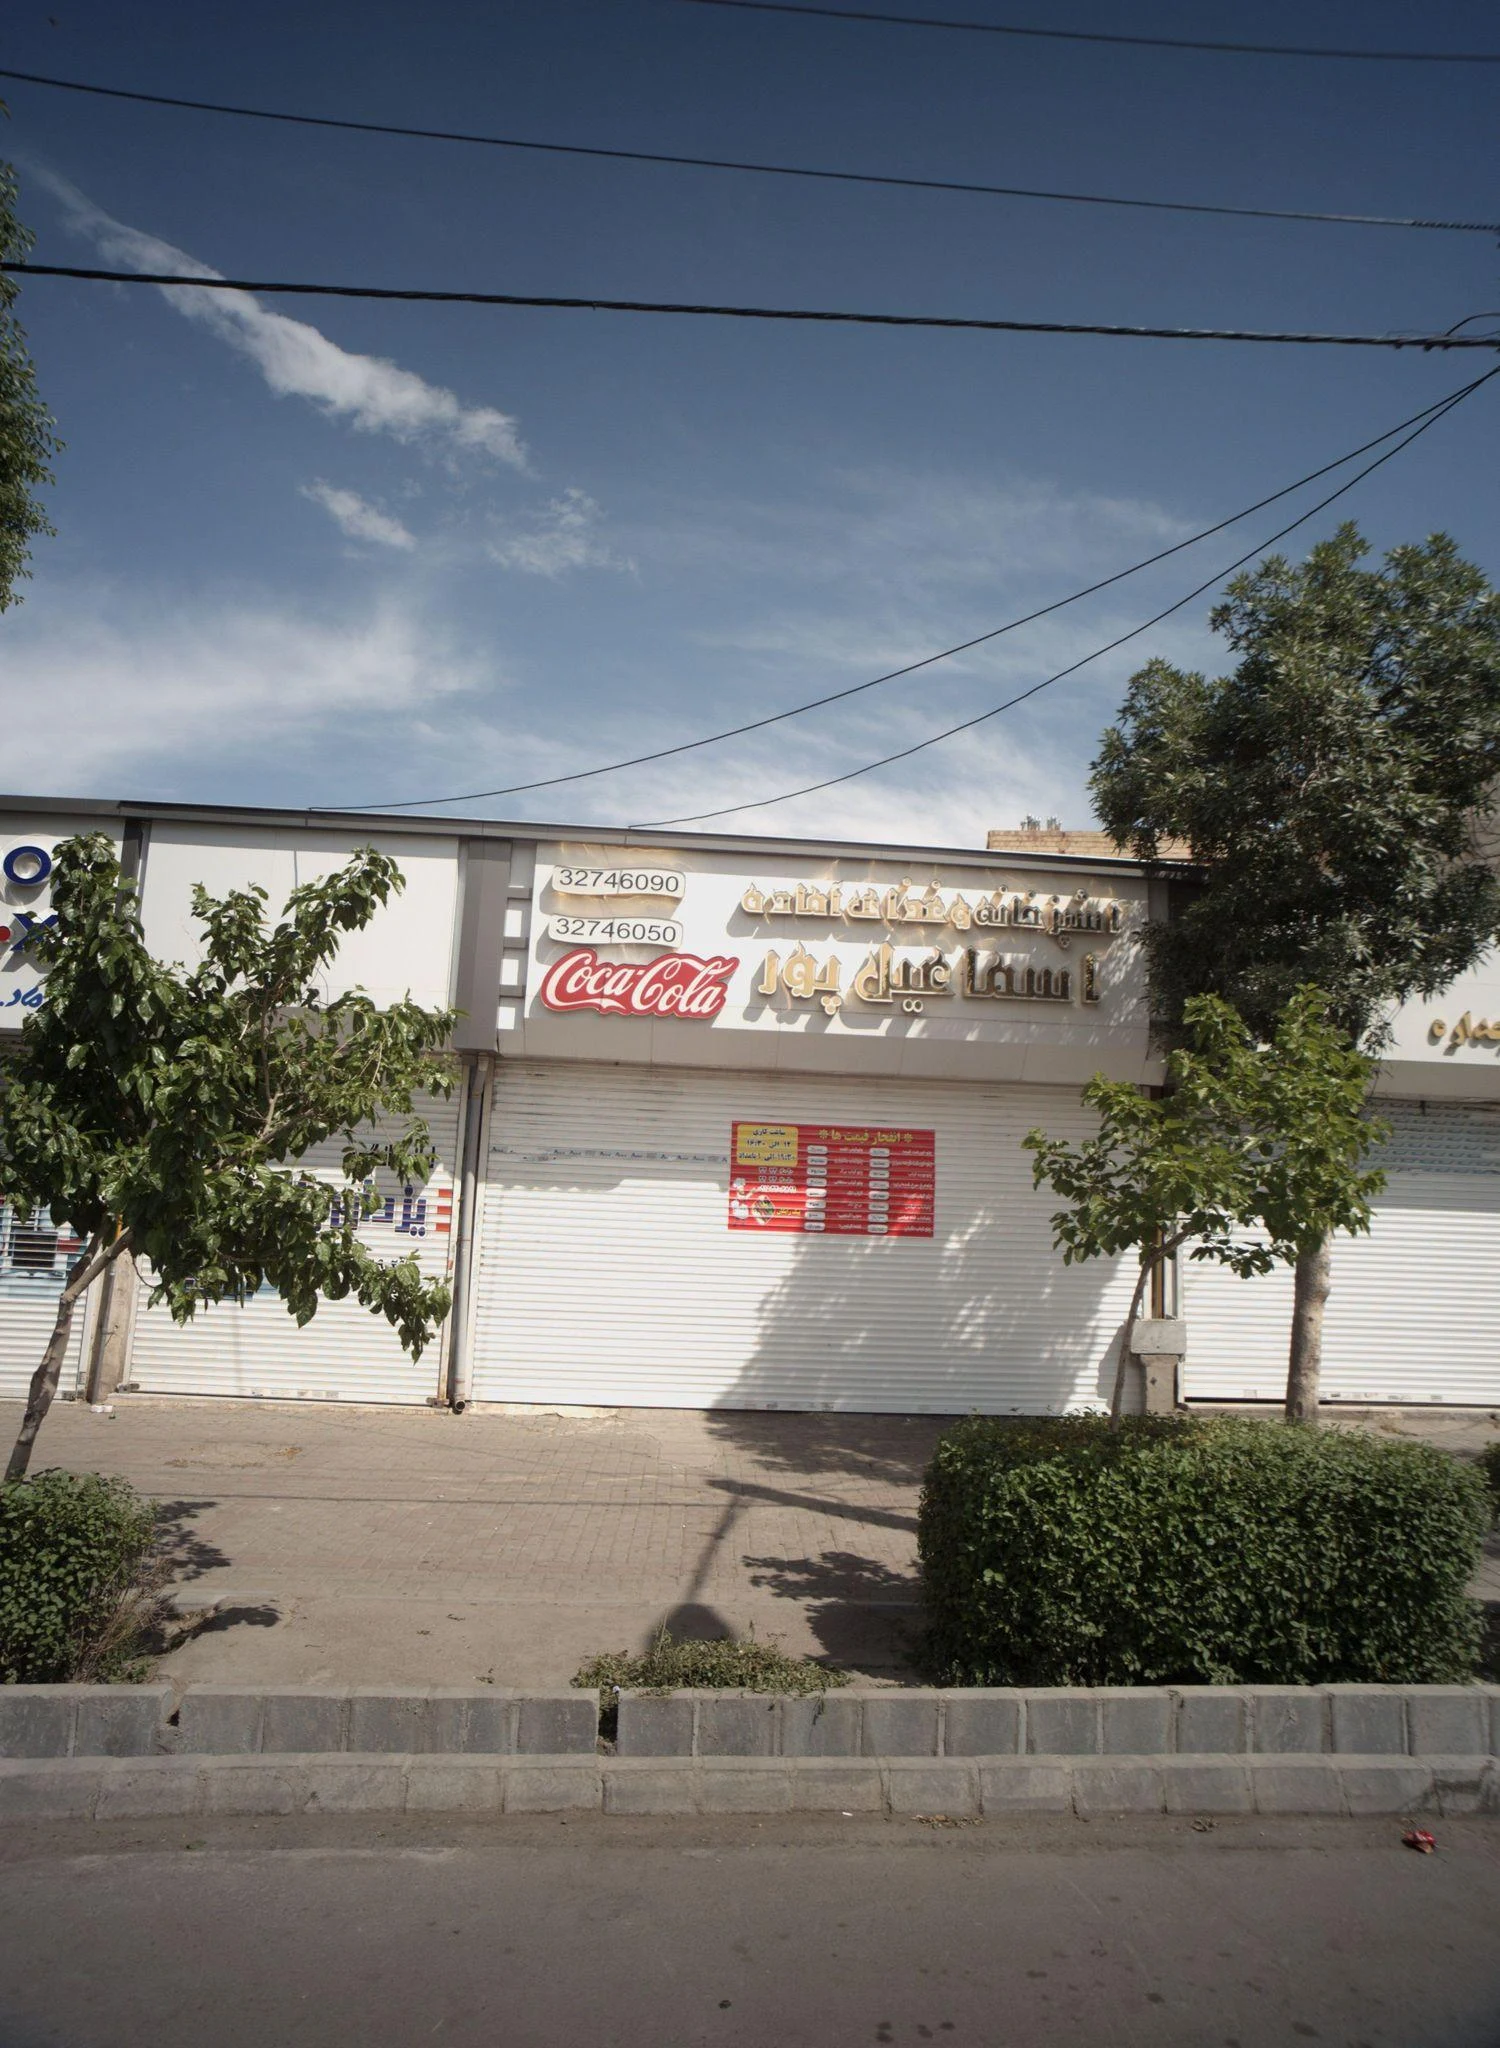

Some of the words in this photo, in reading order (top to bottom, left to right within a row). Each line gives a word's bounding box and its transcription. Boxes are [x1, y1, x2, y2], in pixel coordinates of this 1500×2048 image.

[559, 869, 679, 893] 32746090
[741, 880, 844, 917] آماده
[556, 917, 676, 943] 32746050
[545, 951, 735, 1014] Coca-Cola
[757, 941, 843, 1015] پور
